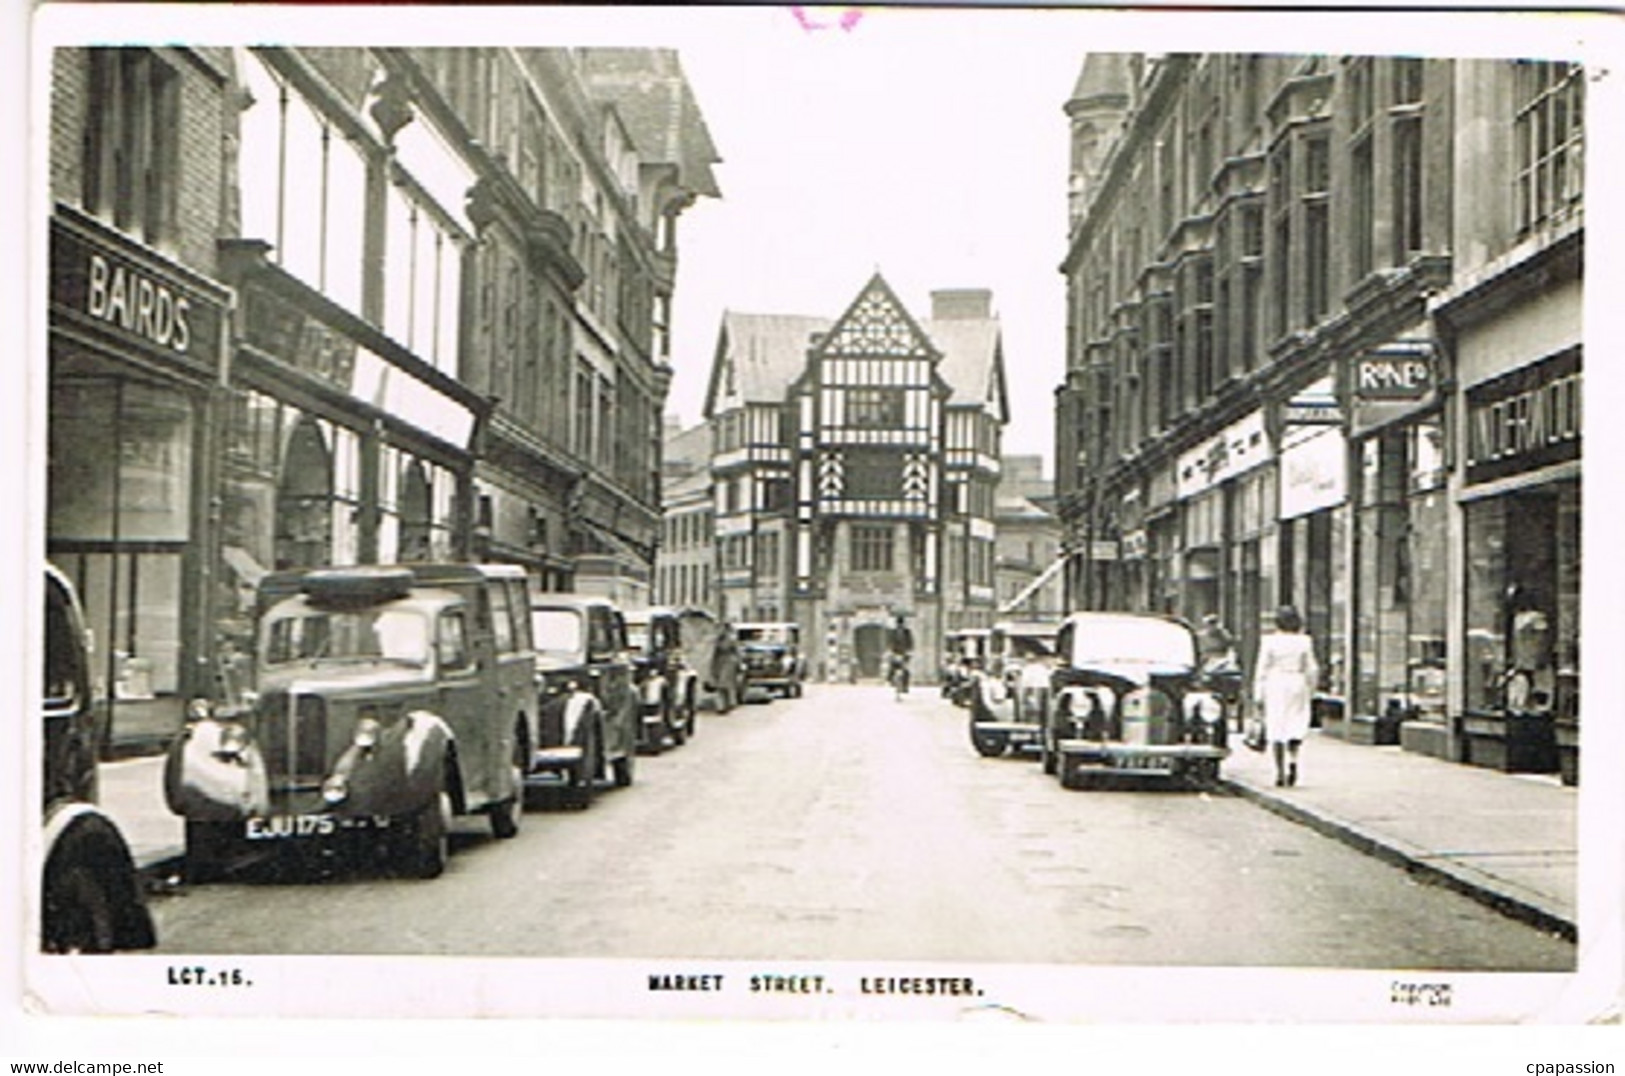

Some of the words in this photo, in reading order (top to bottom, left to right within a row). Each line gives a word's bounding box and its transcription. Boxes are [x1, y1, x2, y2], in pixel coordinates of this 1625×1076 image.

[89, 255, 191, 352] BAIRDS
[648, 975, 724, 992] MARKET
[860, 977, 985, 997] LEICESTER.
